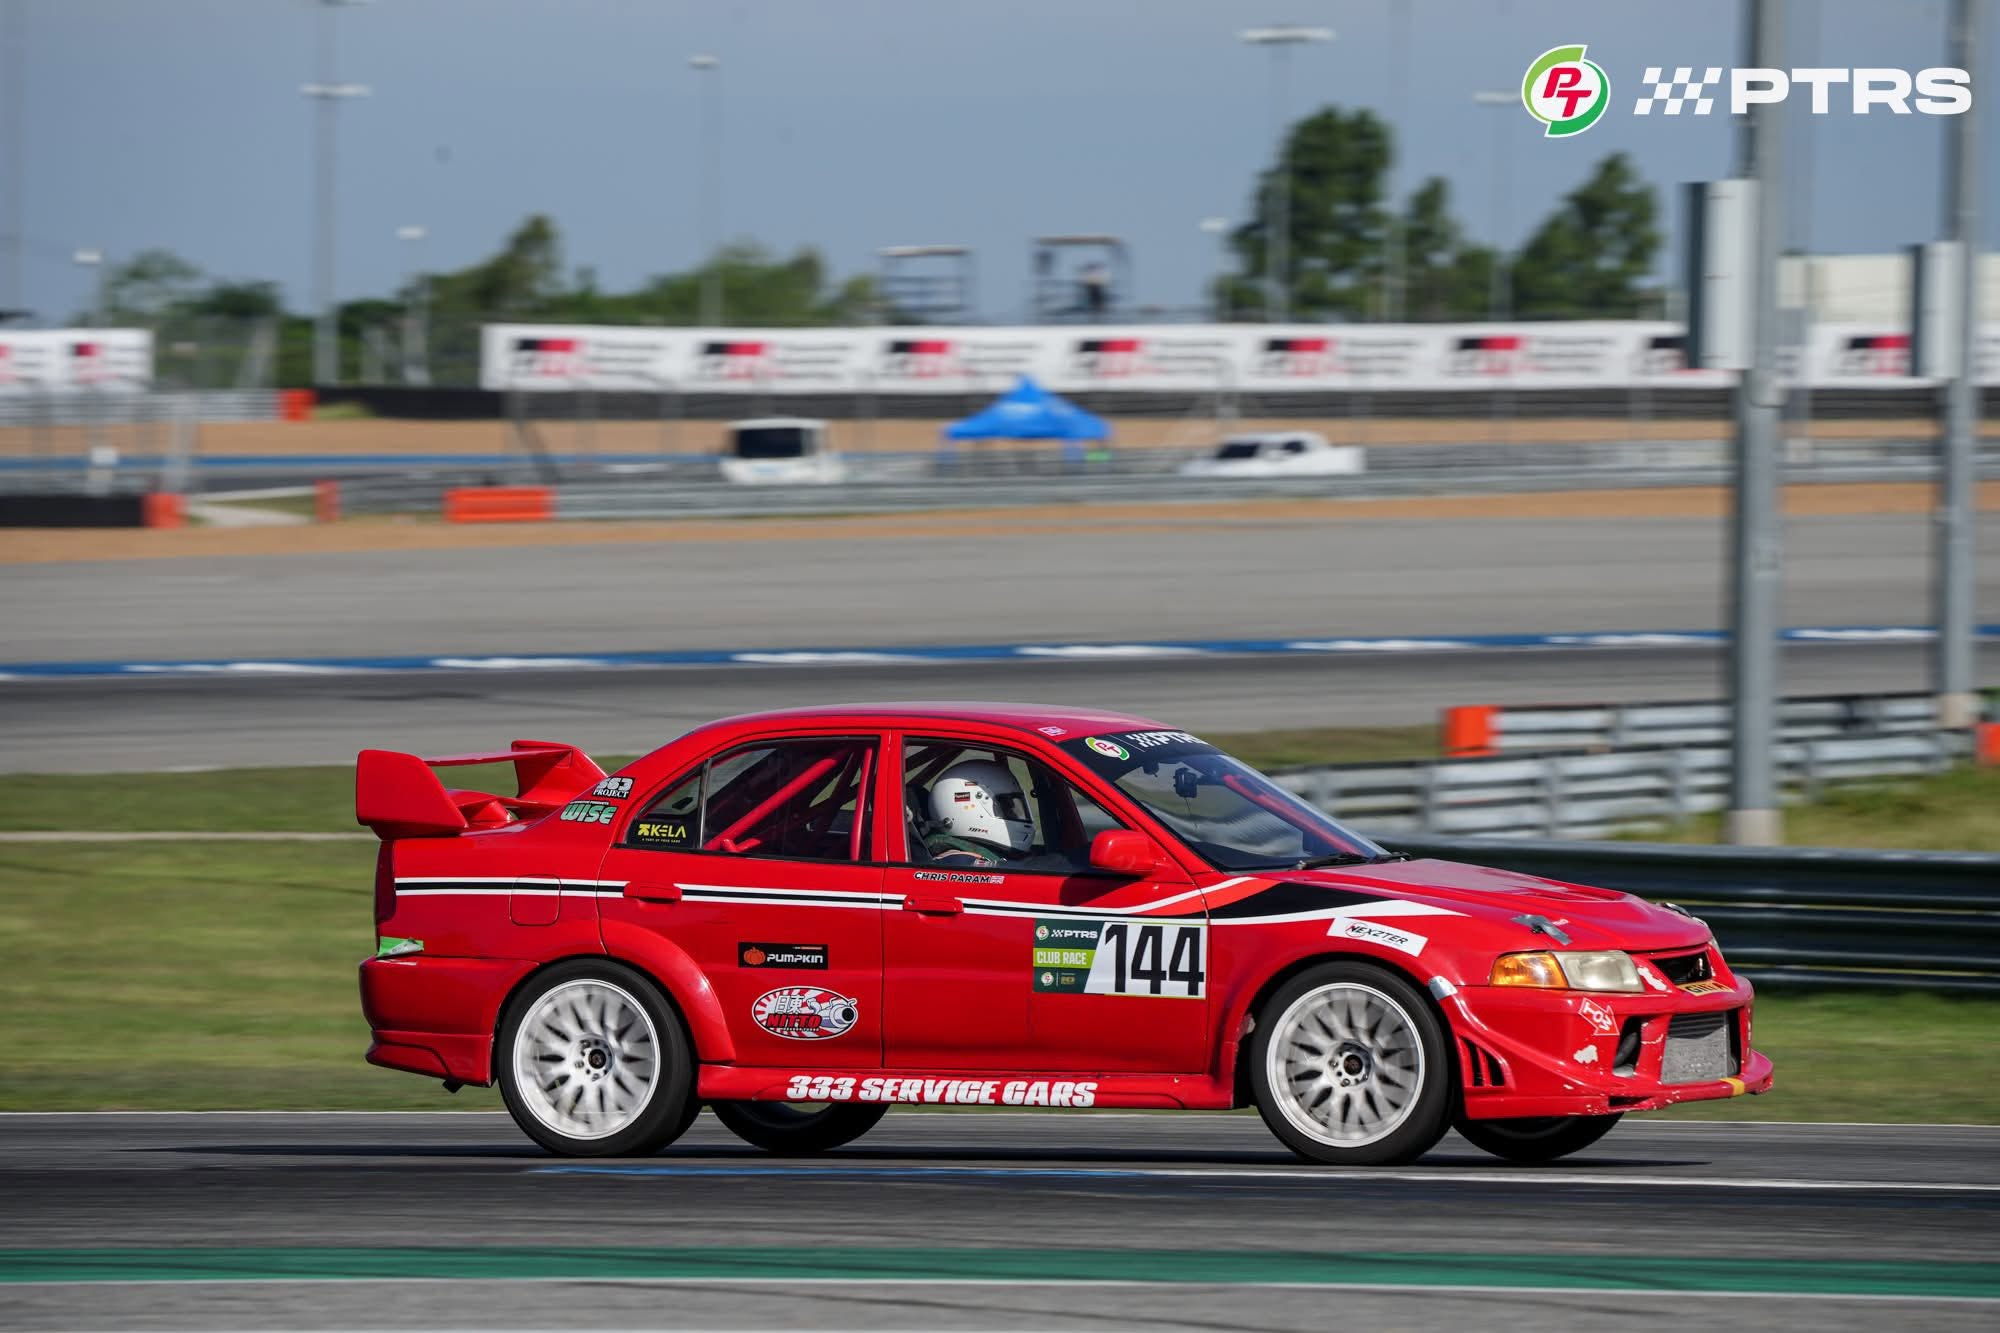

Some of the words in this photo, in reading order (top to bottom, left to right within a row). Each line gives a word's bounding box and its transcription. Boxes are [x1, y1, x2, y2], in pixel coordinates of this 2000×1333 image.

[593, 789, 629, 798] PROJECT
[560, 804, 618, 824] WISE
[914, 872, 948, 881] CHRIS
[950, 874, 991, 883] PARAM
[1063, 929, 1098, 939] PTRS
[1349, 925, 1408, 944] NEXZTER
[766, 953, 824, 964] PUMPKIN
[1036, 951, 1060, 965] CLUB
[1062, 951, 1088, 966] RACE
[1105, 924, 1204, 996] 144
[767, 1014, 821, 1027] NITTO
[1583, 1002, 1612, 1030] TOW
[786, 1075, 857, 1100] 333
[858, 1078, 1000, 1104] SERVICE
[1002, 1080, 1098, 1107] CARS
